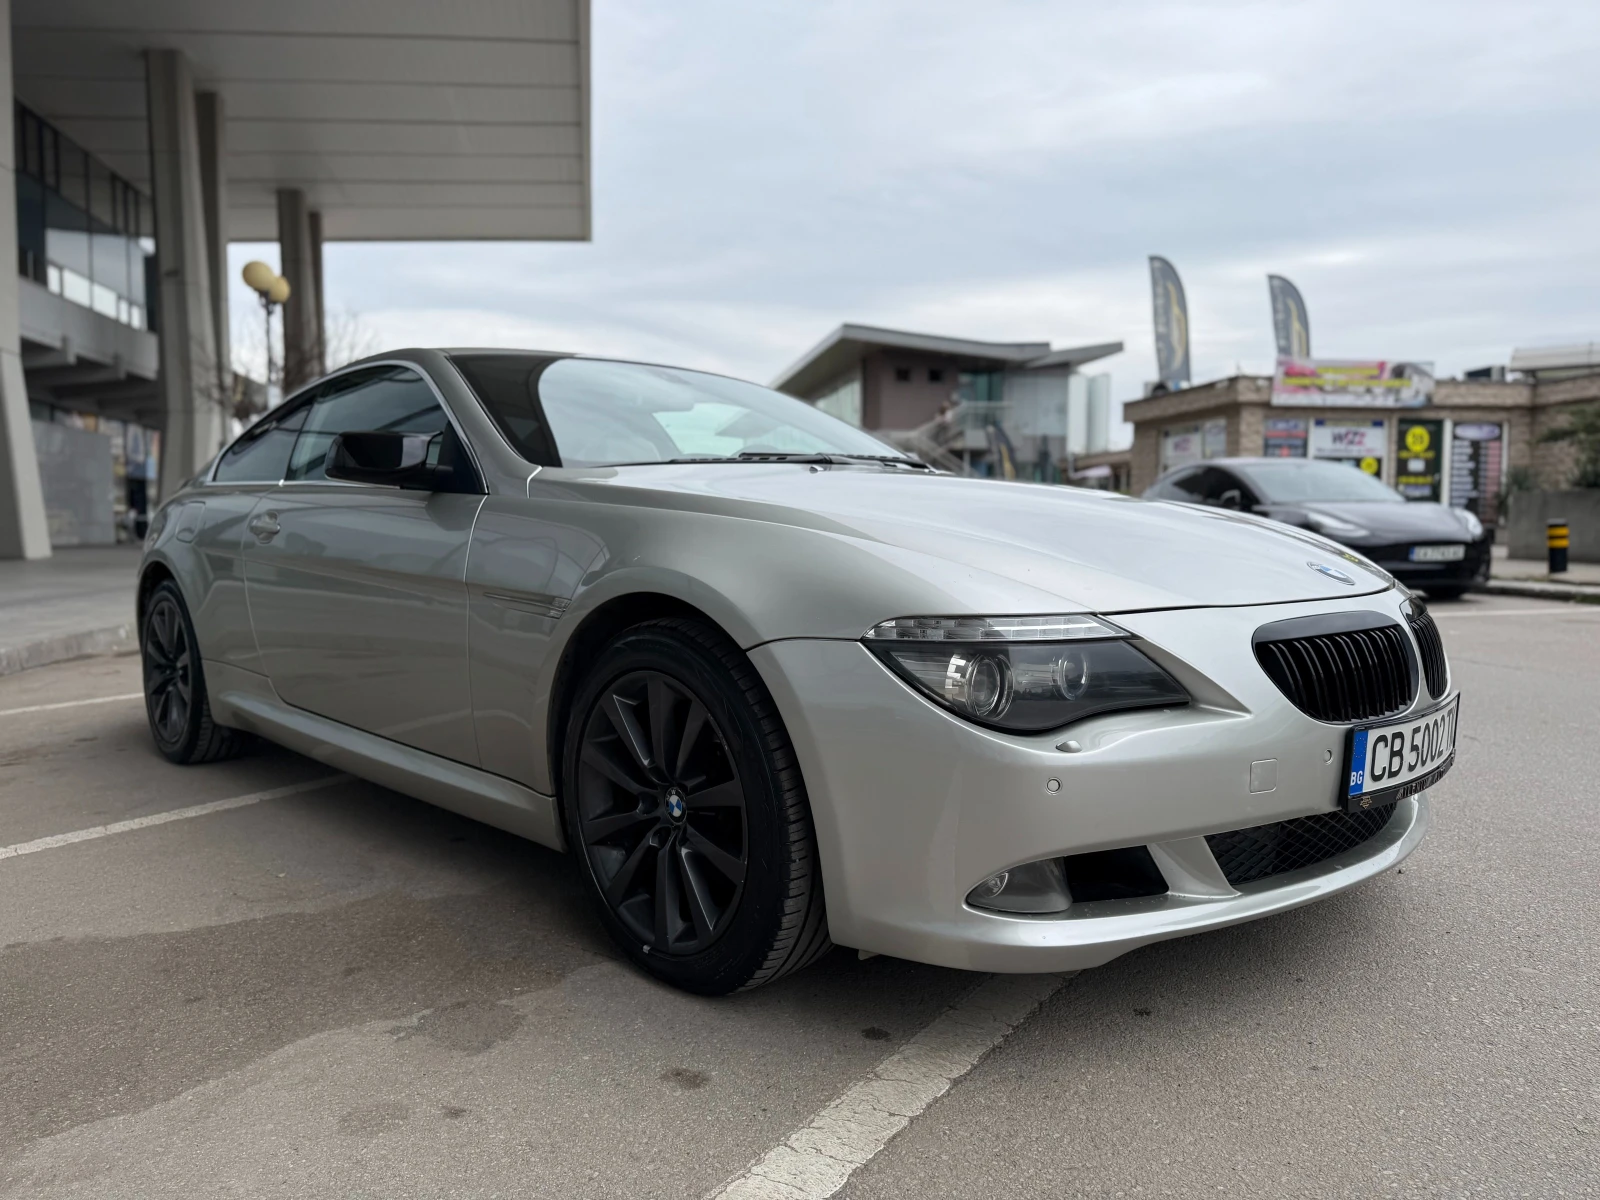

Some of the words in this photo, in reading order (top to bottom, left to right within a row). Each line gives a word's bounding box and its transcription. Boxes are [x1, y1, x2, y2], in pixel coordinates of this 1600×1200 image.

[1370, 731, 1404, 782] CB
[1408, 714, 1446, 772] 5002
[1350, 770, 1363, 785] BG
